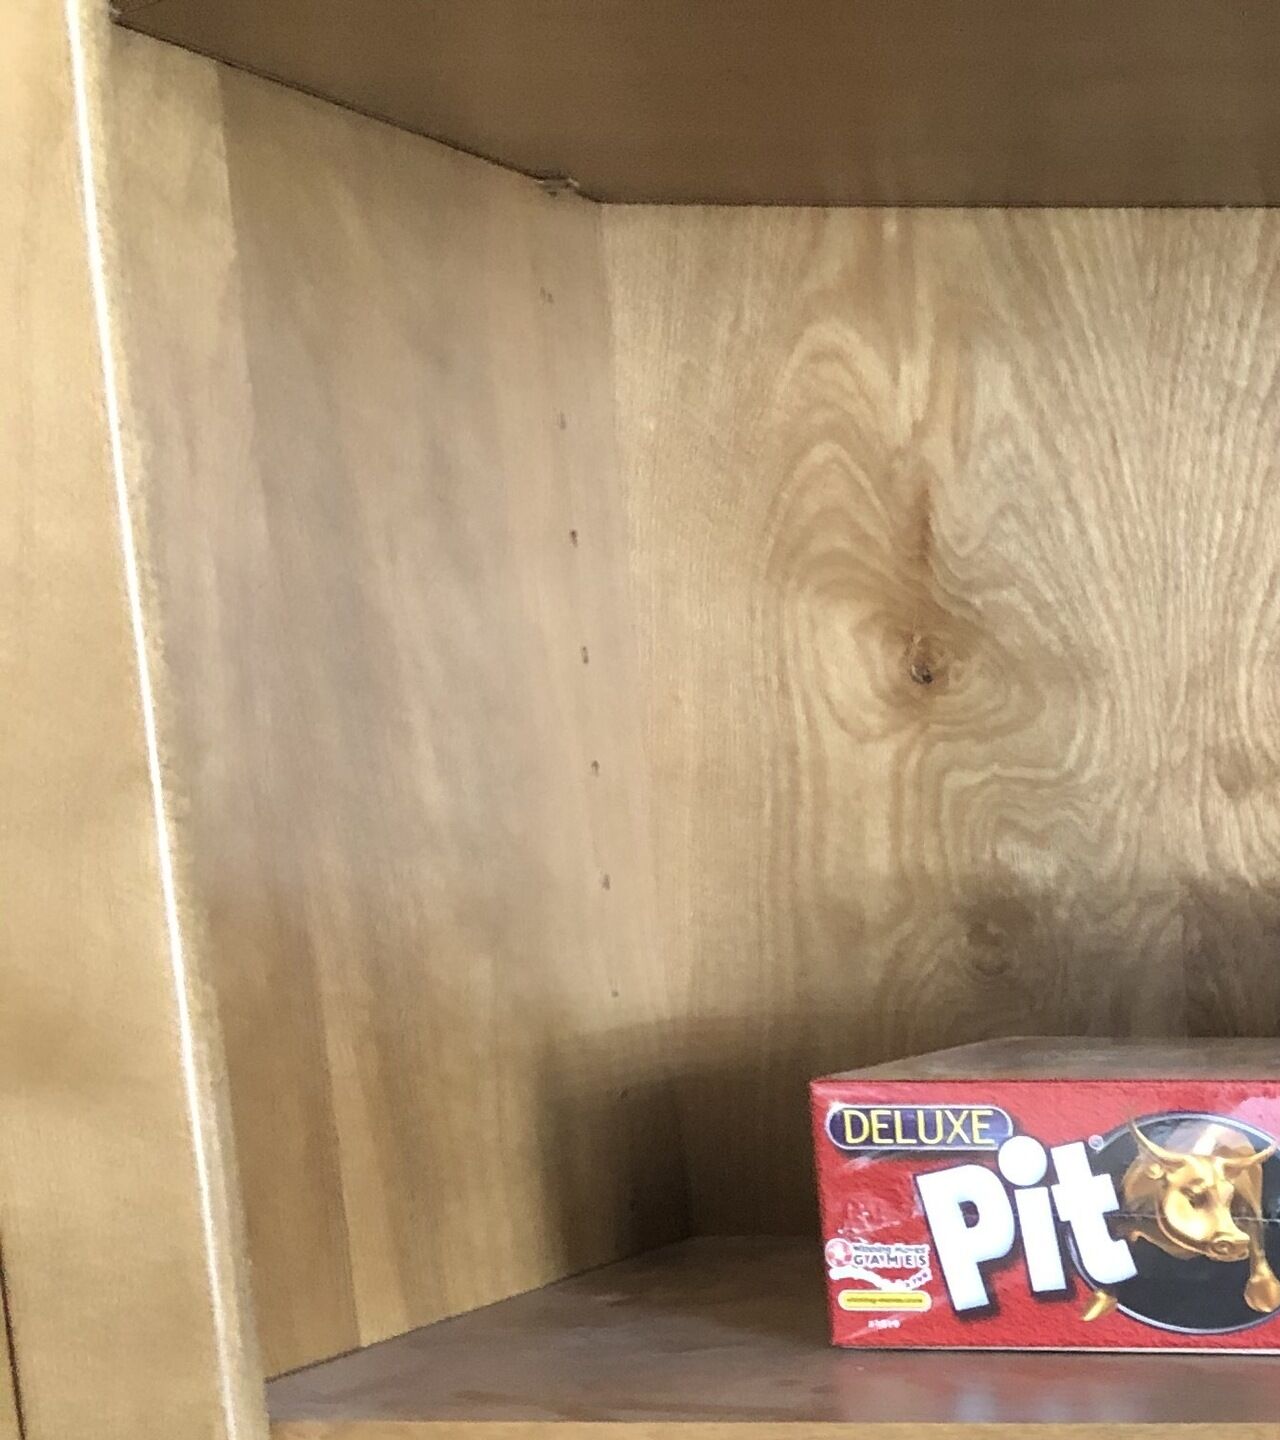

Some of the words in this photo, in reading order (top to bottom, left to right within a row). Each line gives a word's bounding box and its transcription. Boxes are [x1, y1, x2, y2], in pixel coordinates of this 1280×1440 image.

[843, 1106, 995, 1147] DELUXE
[916, 1134, 1138, 1311] Pit
[853, 1254, 927, 1266] GAMES
